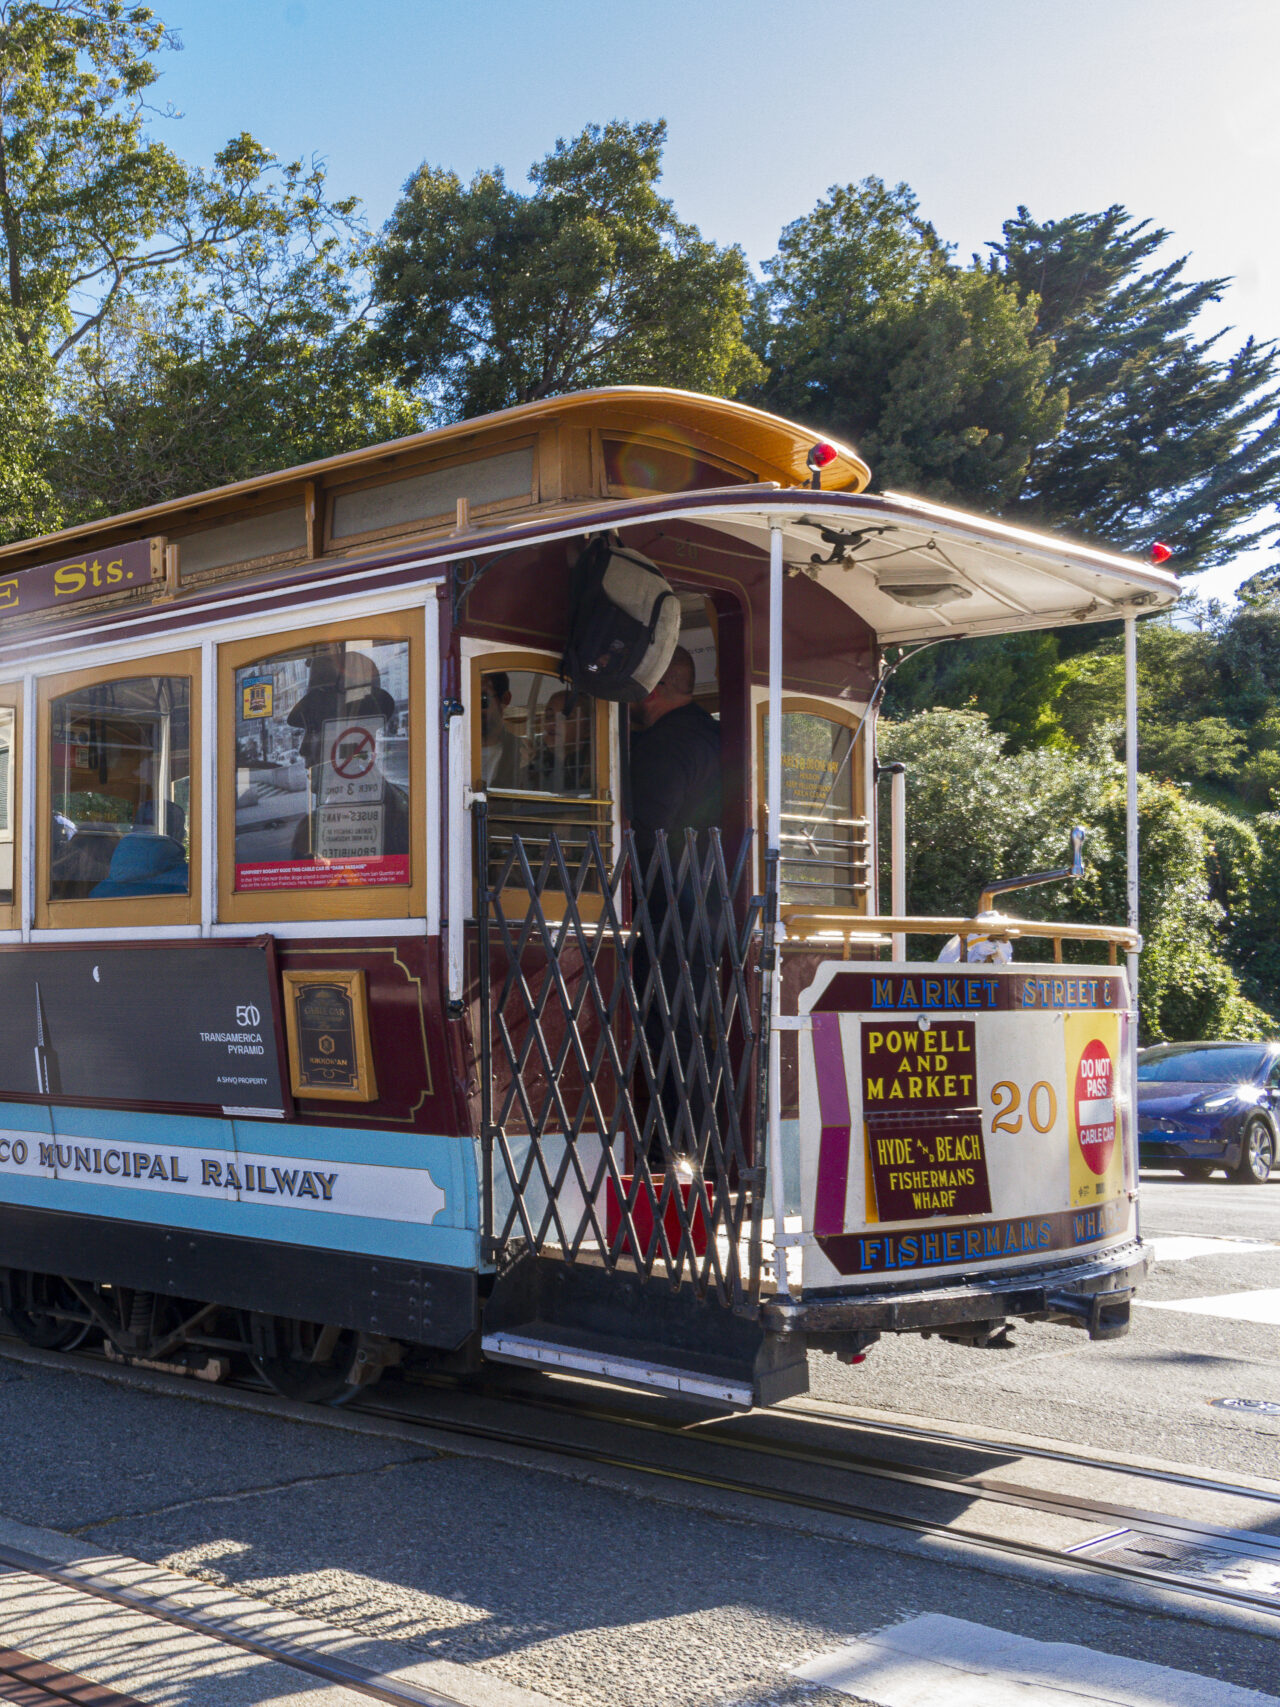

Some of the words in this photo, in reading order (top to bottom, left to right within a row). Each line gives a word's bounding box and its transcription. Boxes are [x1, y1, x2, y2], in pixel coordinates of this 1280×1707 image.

[54, 558, 134, 597] Sts.
[871, 978, 999, 1008] MARKET
[1022, 978, 1098, 1008] STREET
[200, 1032, 263, 1043] TRANSAMERICA
[868, 1030, 971, 1054] POWELL
[228, 1045, 264, 1055] PYRAMID
[897, 1055, 948, 1073] AND
[1080, 1059, 1094, 1077] DO
[1095, 1058, 1111, 1076] NOT
[238, 1077, 267, 1085] PROPERTY
[867, 1074, 973, 1100] MARKET
[1087, 1079, 1107, 1098] PASS
[991, 1080, 1058, 1134] 20
[1080, 1129, 1102, 1145] CABLE
[1102, 1126, 1114, 1143] CAR
[876, 1138, 915, 1165] HYDE
[916, 1139, 935, 1163] AND
[936, 1134, 982, 1163] BEACH
[39, 1141, 188, 1183] MUNICIPAL
[201, 1159, 339, 1200] RAILWAY
[889, 1168, 975, 1191] FISHERMANS
[911, 1190, 957, 1210] WHARF
[860, 1219, 1052, 1271] FISHERMANS
